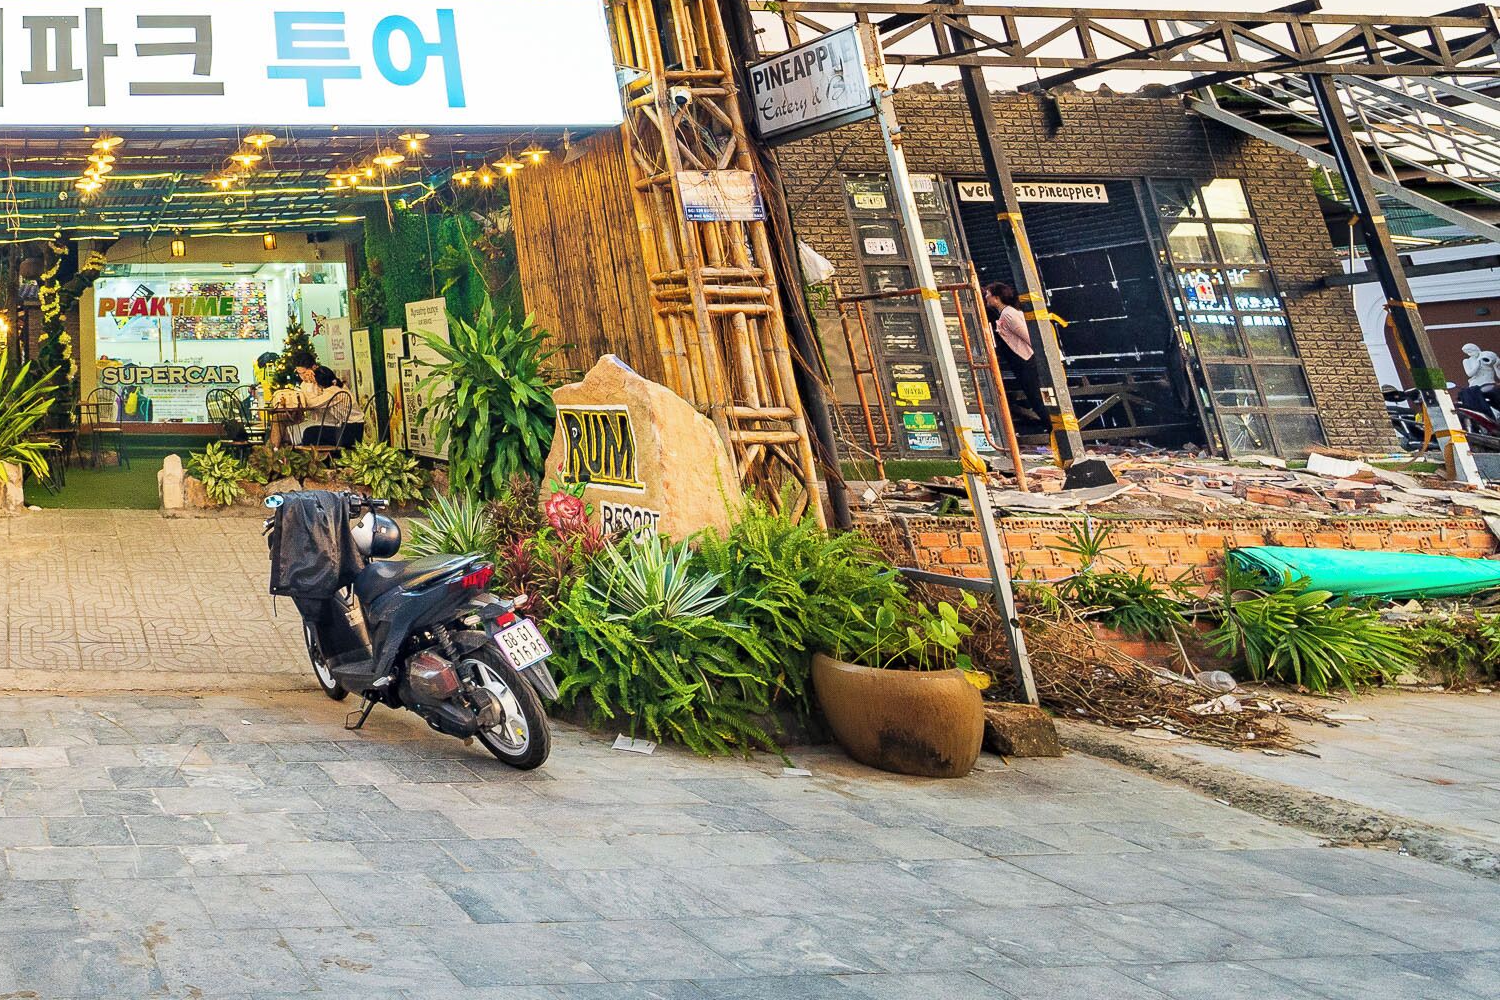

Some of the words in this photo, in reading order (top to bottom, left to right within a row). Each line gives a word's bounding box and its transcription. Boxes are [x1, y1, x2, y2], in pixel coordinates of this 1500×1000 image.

[267, 8, 467, 109] 투어
[759, 96, 808, 121] Eatery
[961, 184, 1021, 198] Wele
[102, 365, 240, 385] SUPERCAR
[559, 410, 636, 484] RUM
